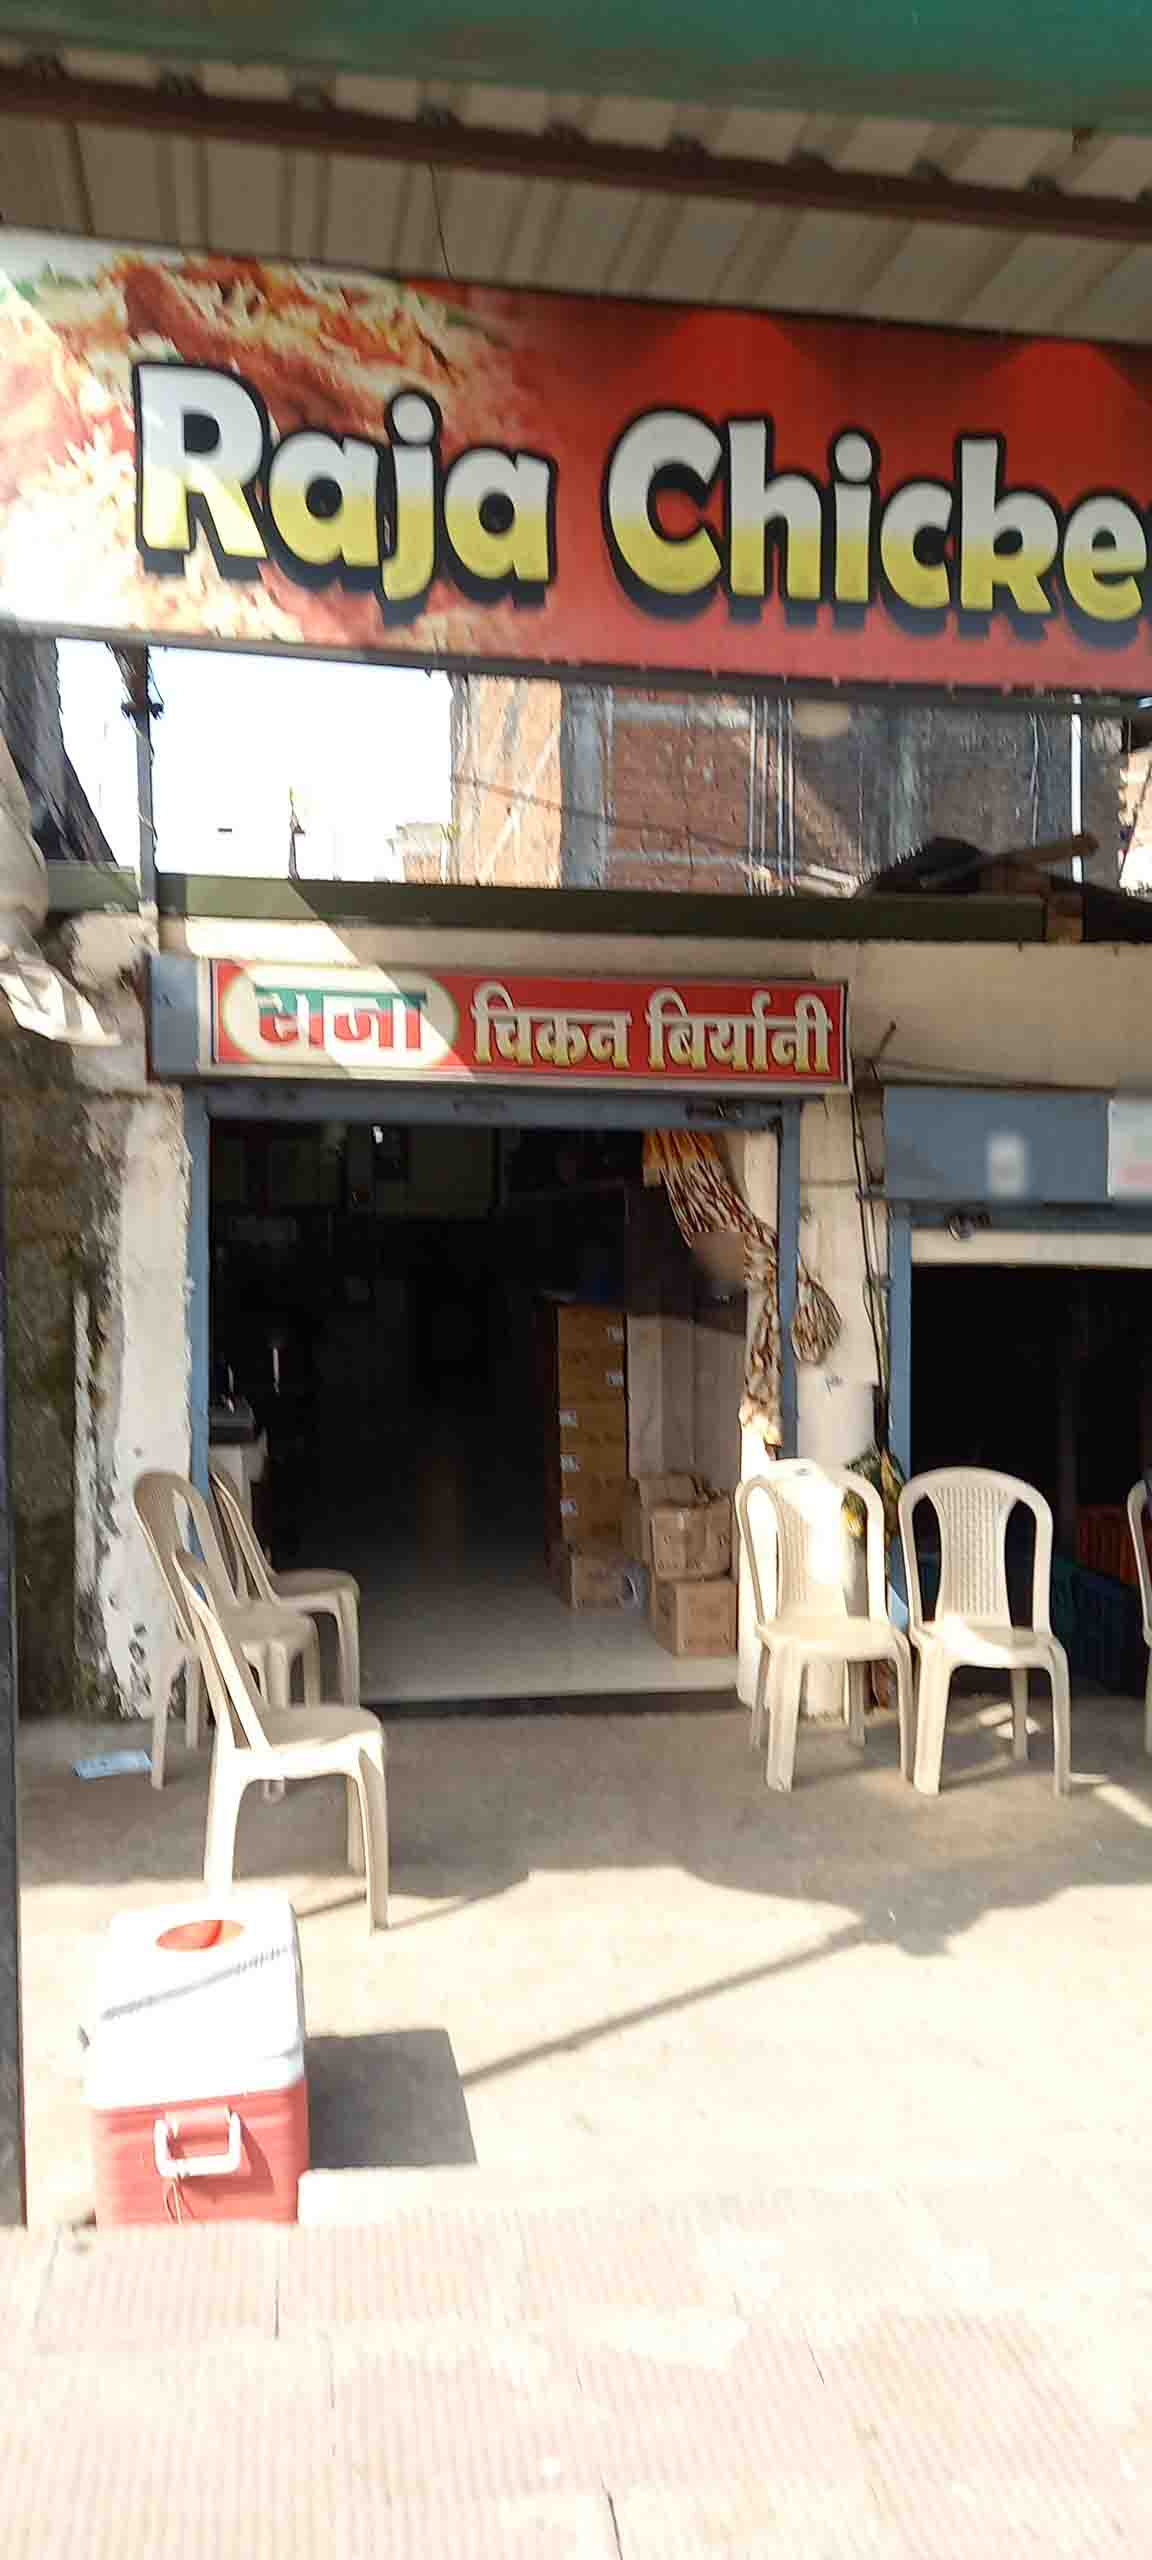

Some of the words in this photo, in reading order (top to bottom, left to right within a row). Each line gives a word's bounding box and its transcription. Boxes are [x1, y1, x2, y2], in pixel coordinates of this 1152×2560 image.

[135, 363, 556, 614] Raja
[605, 408, 1152, 634] Chicke
[255, 984, 427, 1051] राजा
[471, 980, 632, 1069] चिकन
[645, 986, 832, 1073] बिर्यानी
